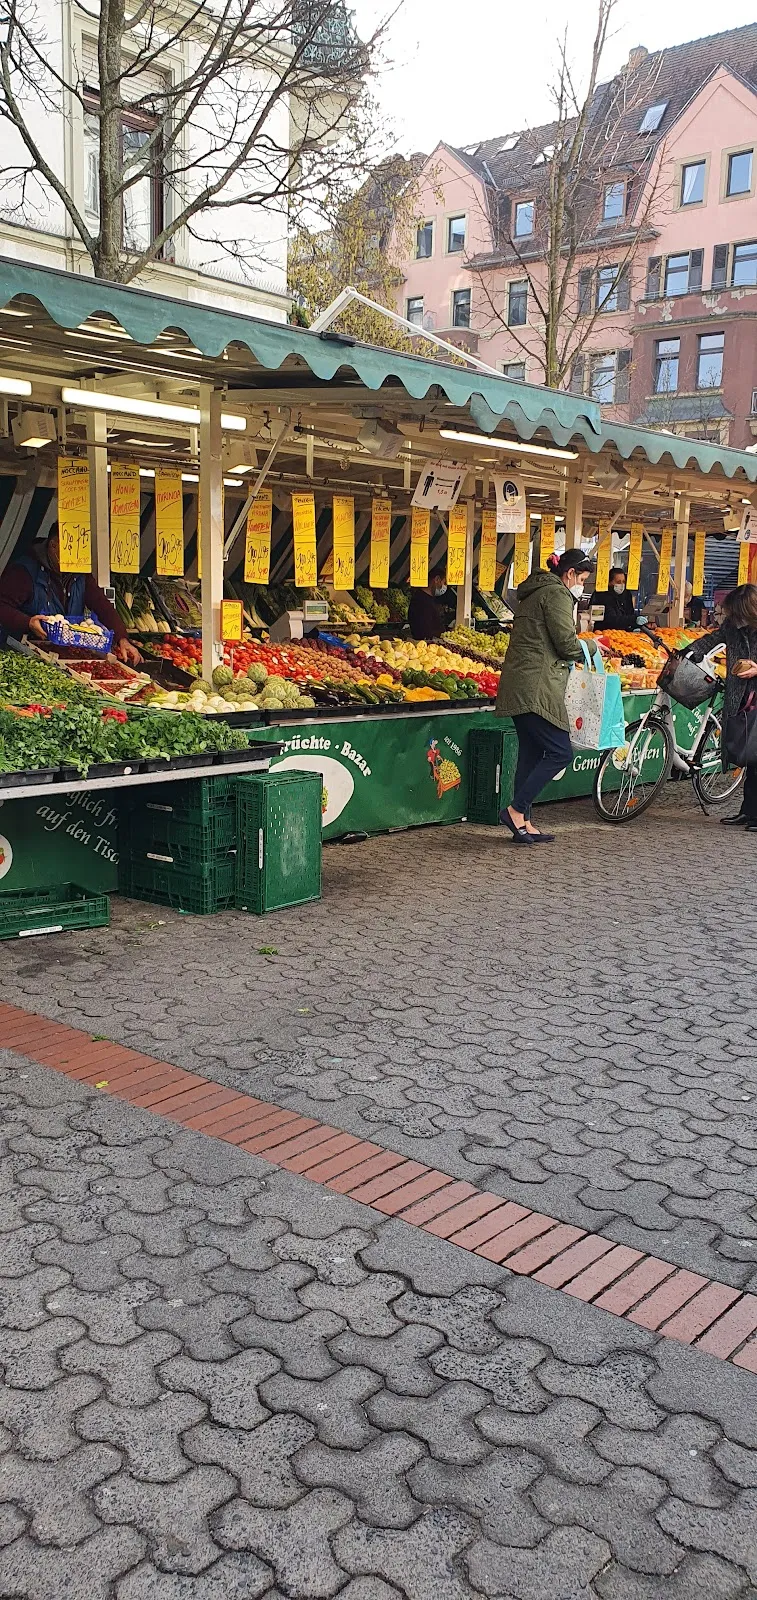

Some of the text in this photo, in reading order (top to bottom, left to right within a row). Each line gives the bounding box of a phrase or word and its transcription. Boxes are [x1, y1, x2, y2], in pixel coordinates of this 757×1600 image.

[340, 740, 372, 777] Bazar
[449, 741, 463, 757] 1986
[36, 805, 73, 831] auf
[65, 819, 91, 845] den
[92, 835, 120, 865] Tisc
